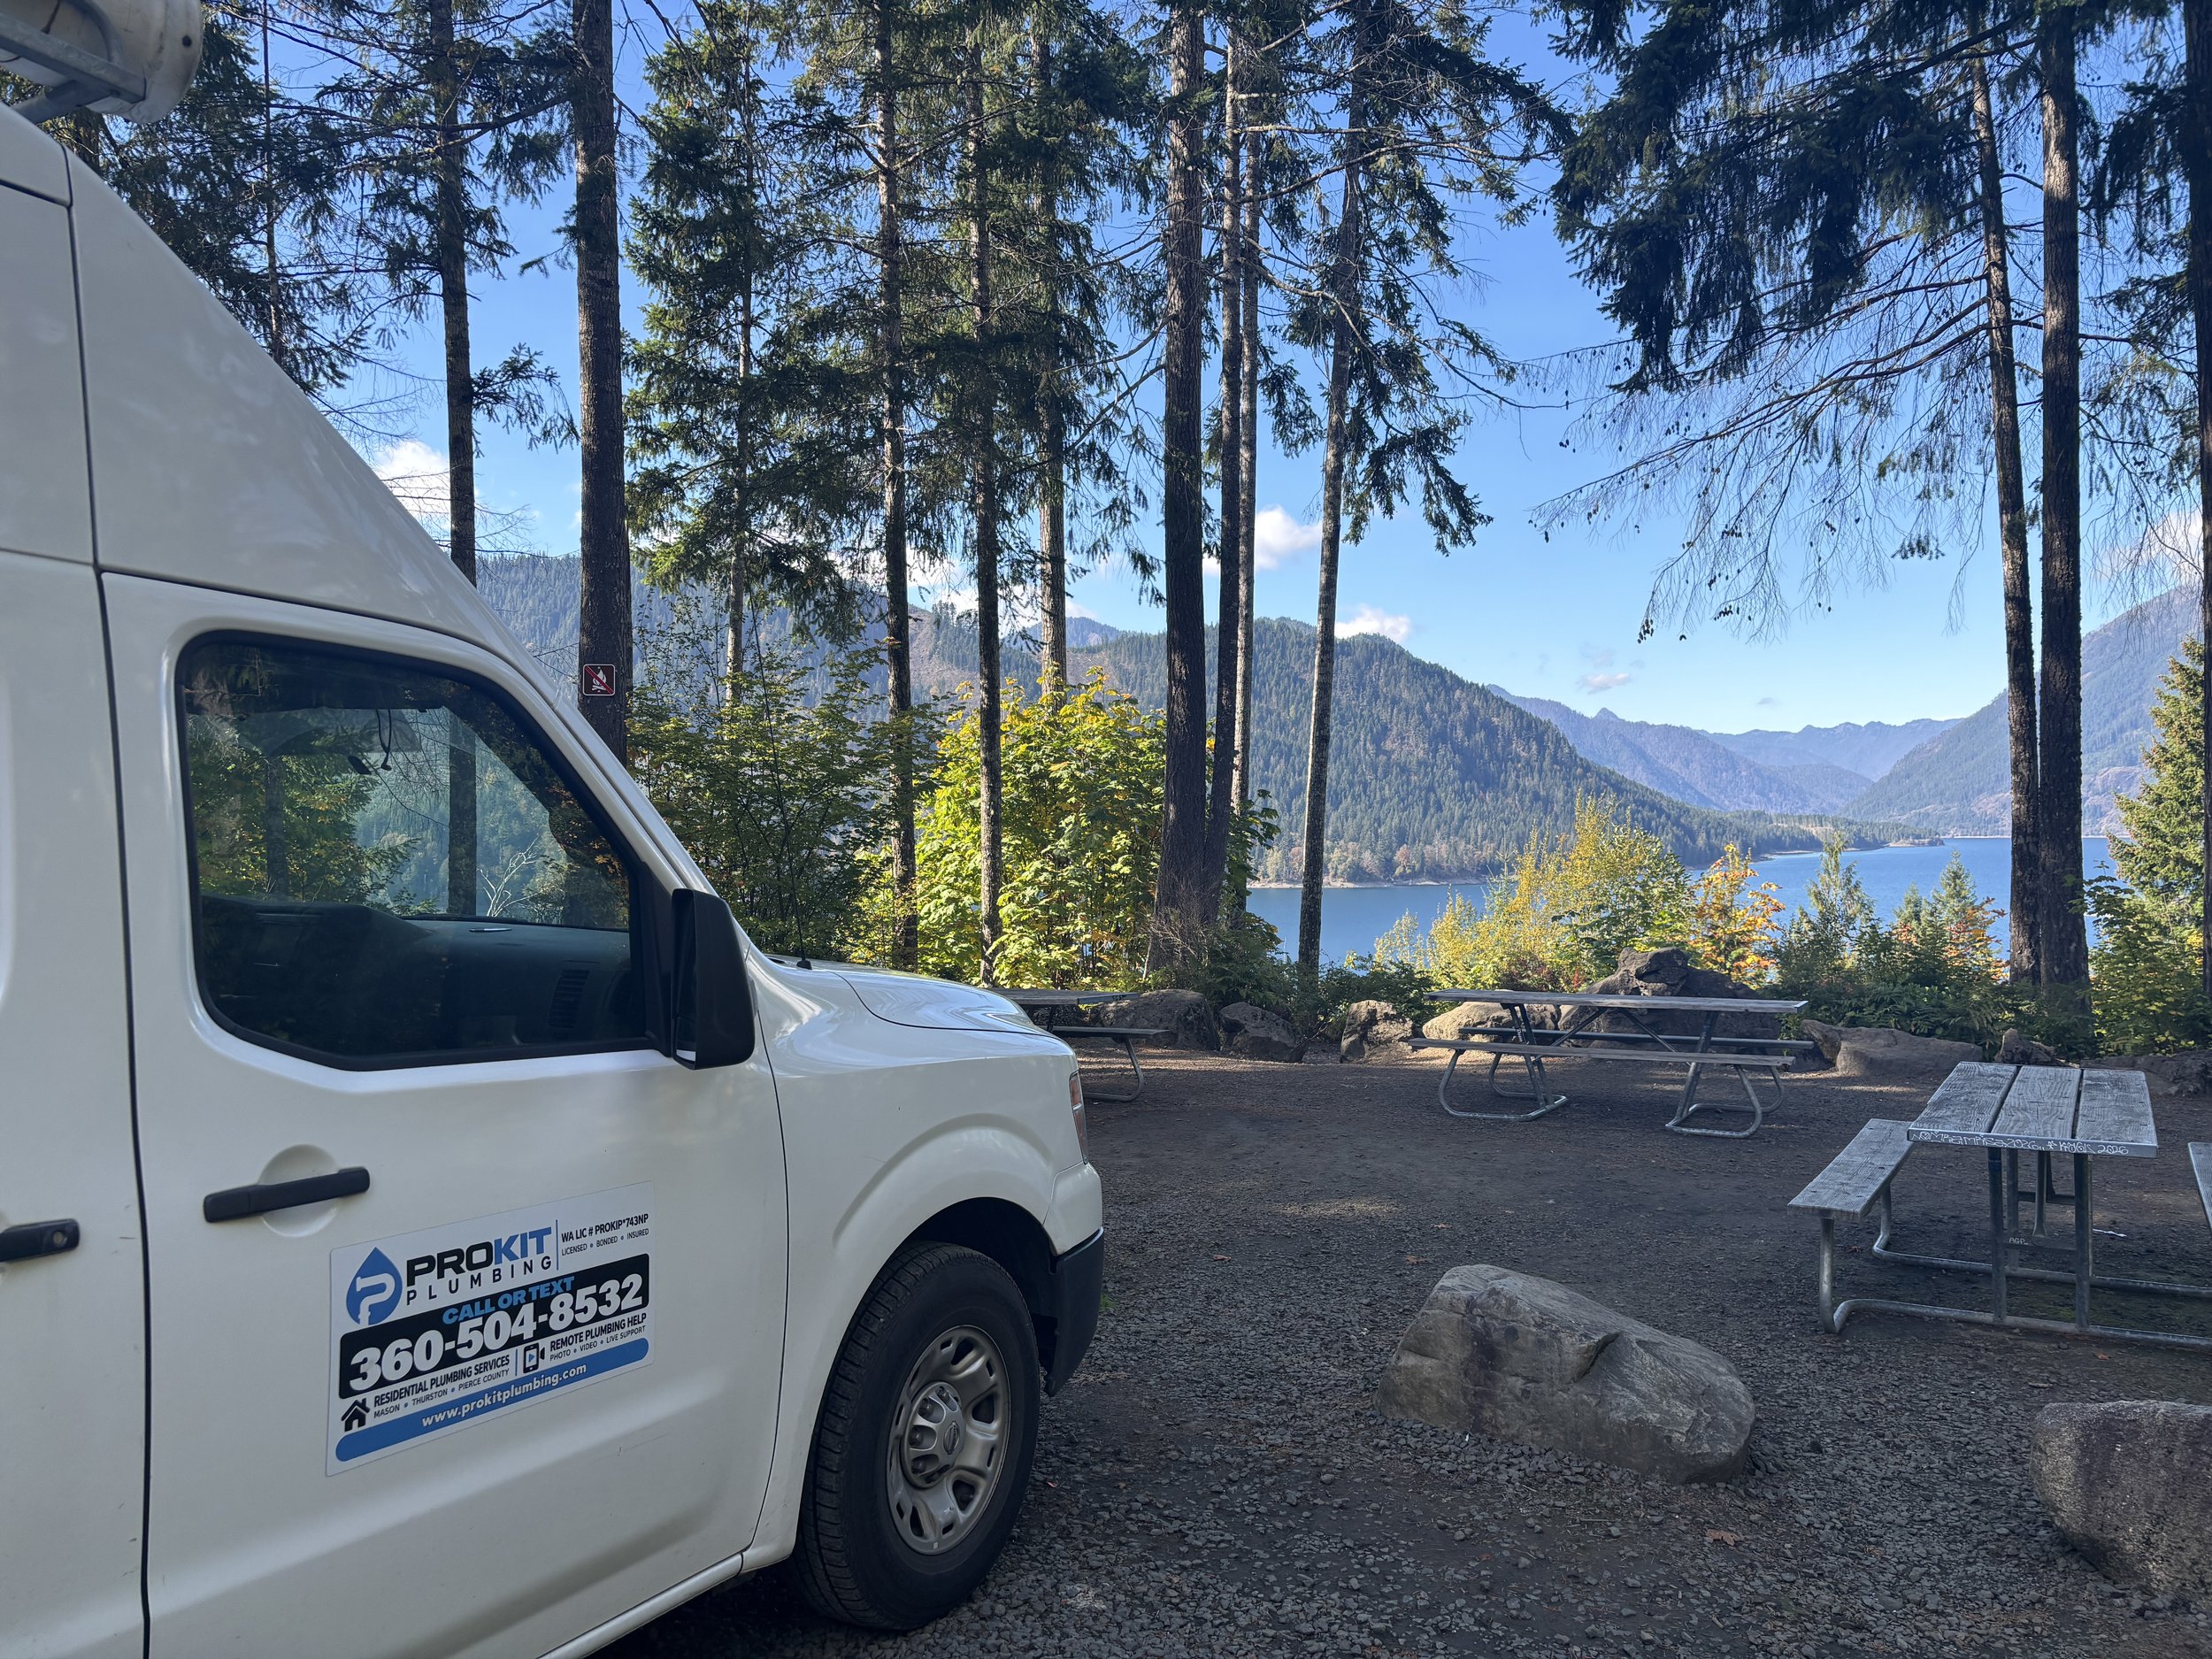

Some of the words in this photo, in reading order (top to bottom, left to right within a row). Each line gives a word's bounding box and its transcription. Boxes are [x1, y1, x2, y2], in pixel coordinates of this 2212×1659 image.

[406, 1226, 552, 1287] PROKIT
[561, 1231, 574, 1243] WA
[575, 1227, 588, 1240] LIC
[588, 1226, 594, 1237] #
[561, 1243, 588, 1256] LICENSED
[596, 1235, 618, 1248] BONDED
[626, 1228, 649, 1240] INSURED
[406, 1256, 552, 1306] PLUMBING
[442, 1298, 487, 1325] CALL
[497, 1289, 526, 1310] OR
[529, 1276, 575, 1301] TEXT
[349, 1273, 643, 1391] 360-504-8532
[550, 1332, 584, 1352] REMOTE
[585, 1319, 626, 1340] PLUMBING
[627, 1312, 647, 1328] HELP
[550, 1348, 572, 1362] PHOTO
[580, 1340, 598, 1352] VIDEO
[606, 1333, 619, 1344] LIVE
[620, 1325, 646, 1340] SUPPORT
[373, 1379, 429, 1408] RESIDENTIAL
[430, 1365, 473, 1389] PLUMBING
[473, 1355, 511, 1376] SERVICES
[373, 1403, 400, 1419] MASON
[412, 1388, 449, 1406] THURSTON
[458, 1378, 481, 1392] PIERCE
[482, 1368, 511, 1383] COUNTY
[422, 1363, 587, 1427] www.prokitplumbing.com
